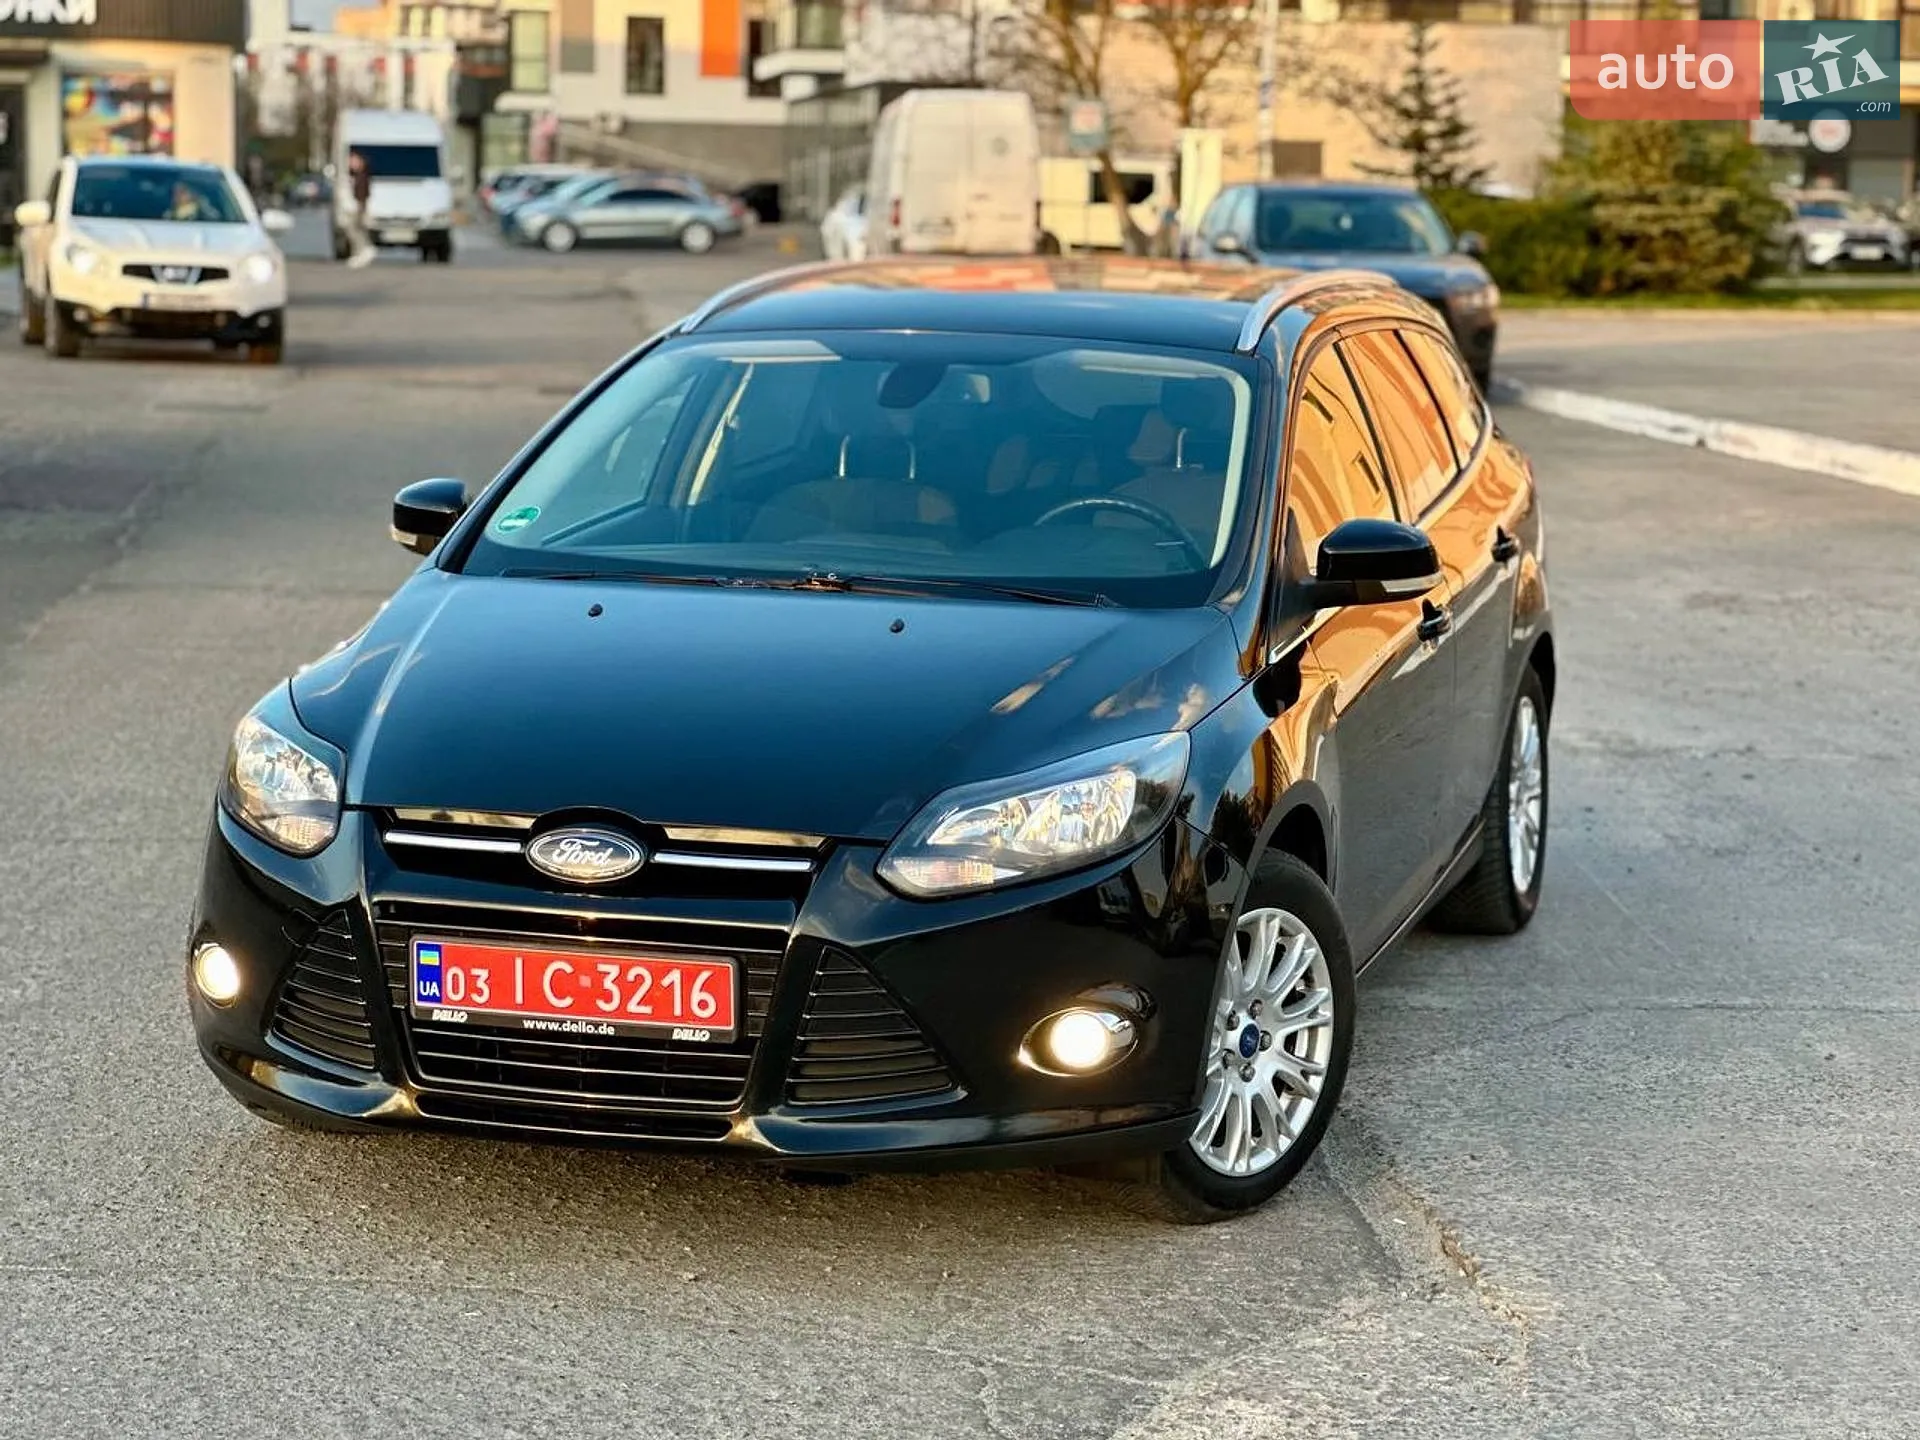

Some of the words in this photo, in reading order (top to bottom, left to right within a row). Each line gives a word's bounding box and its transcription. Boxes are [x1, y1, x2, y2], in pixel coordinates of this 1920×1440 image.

[551, 837, 613, 867] Ford
[419, 980, 440, 997] UA
[446, 966, 491, 1005] 03
[595, 963, 718, 1020] 3216
[523, 1018, 616, 1036] www.dello.de
